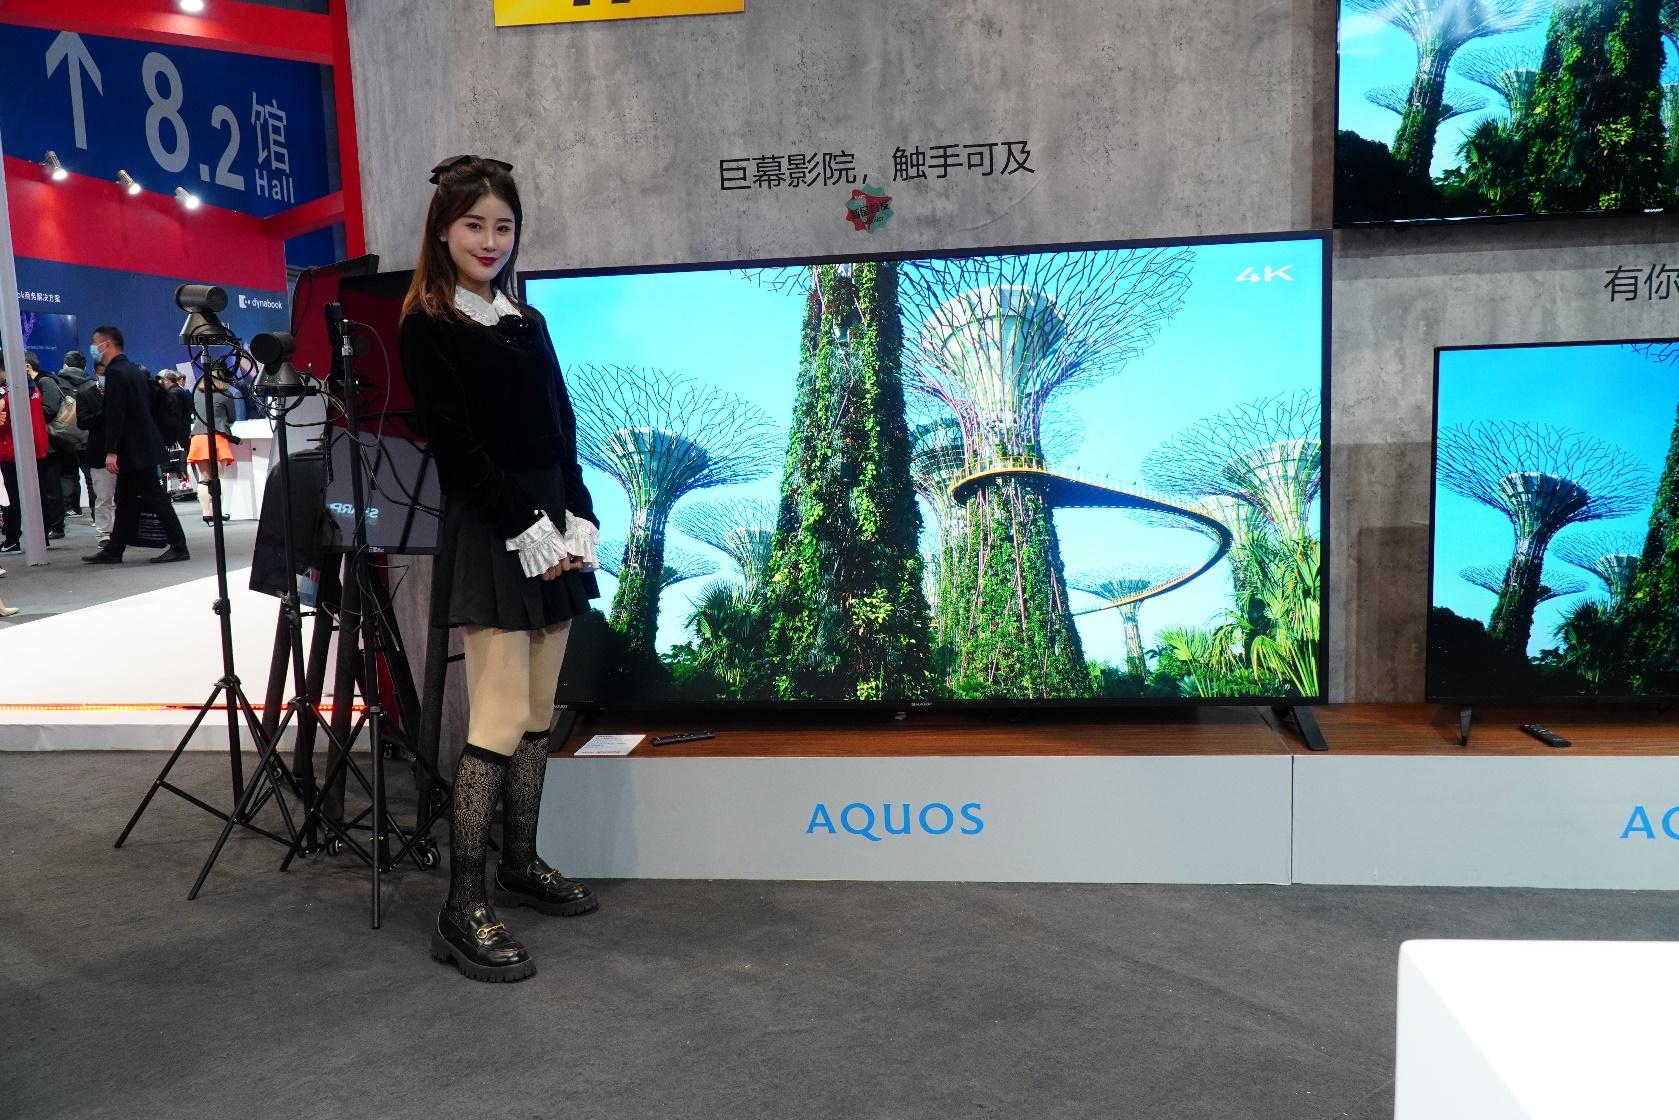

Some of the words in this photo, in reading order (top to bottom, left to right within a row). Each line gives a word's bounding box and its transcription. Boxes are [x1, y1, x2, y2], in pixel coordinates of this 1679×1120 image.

[142, 52, 245, 191] 8.2
[251, 90, 290, 174] 馆
[255, 167, 294, 204] Hall
[1235, 265, 1295, 283] 4K
[252, 297, 283, 309] dynabook
[805, 802, 984, 842] AQUOS
